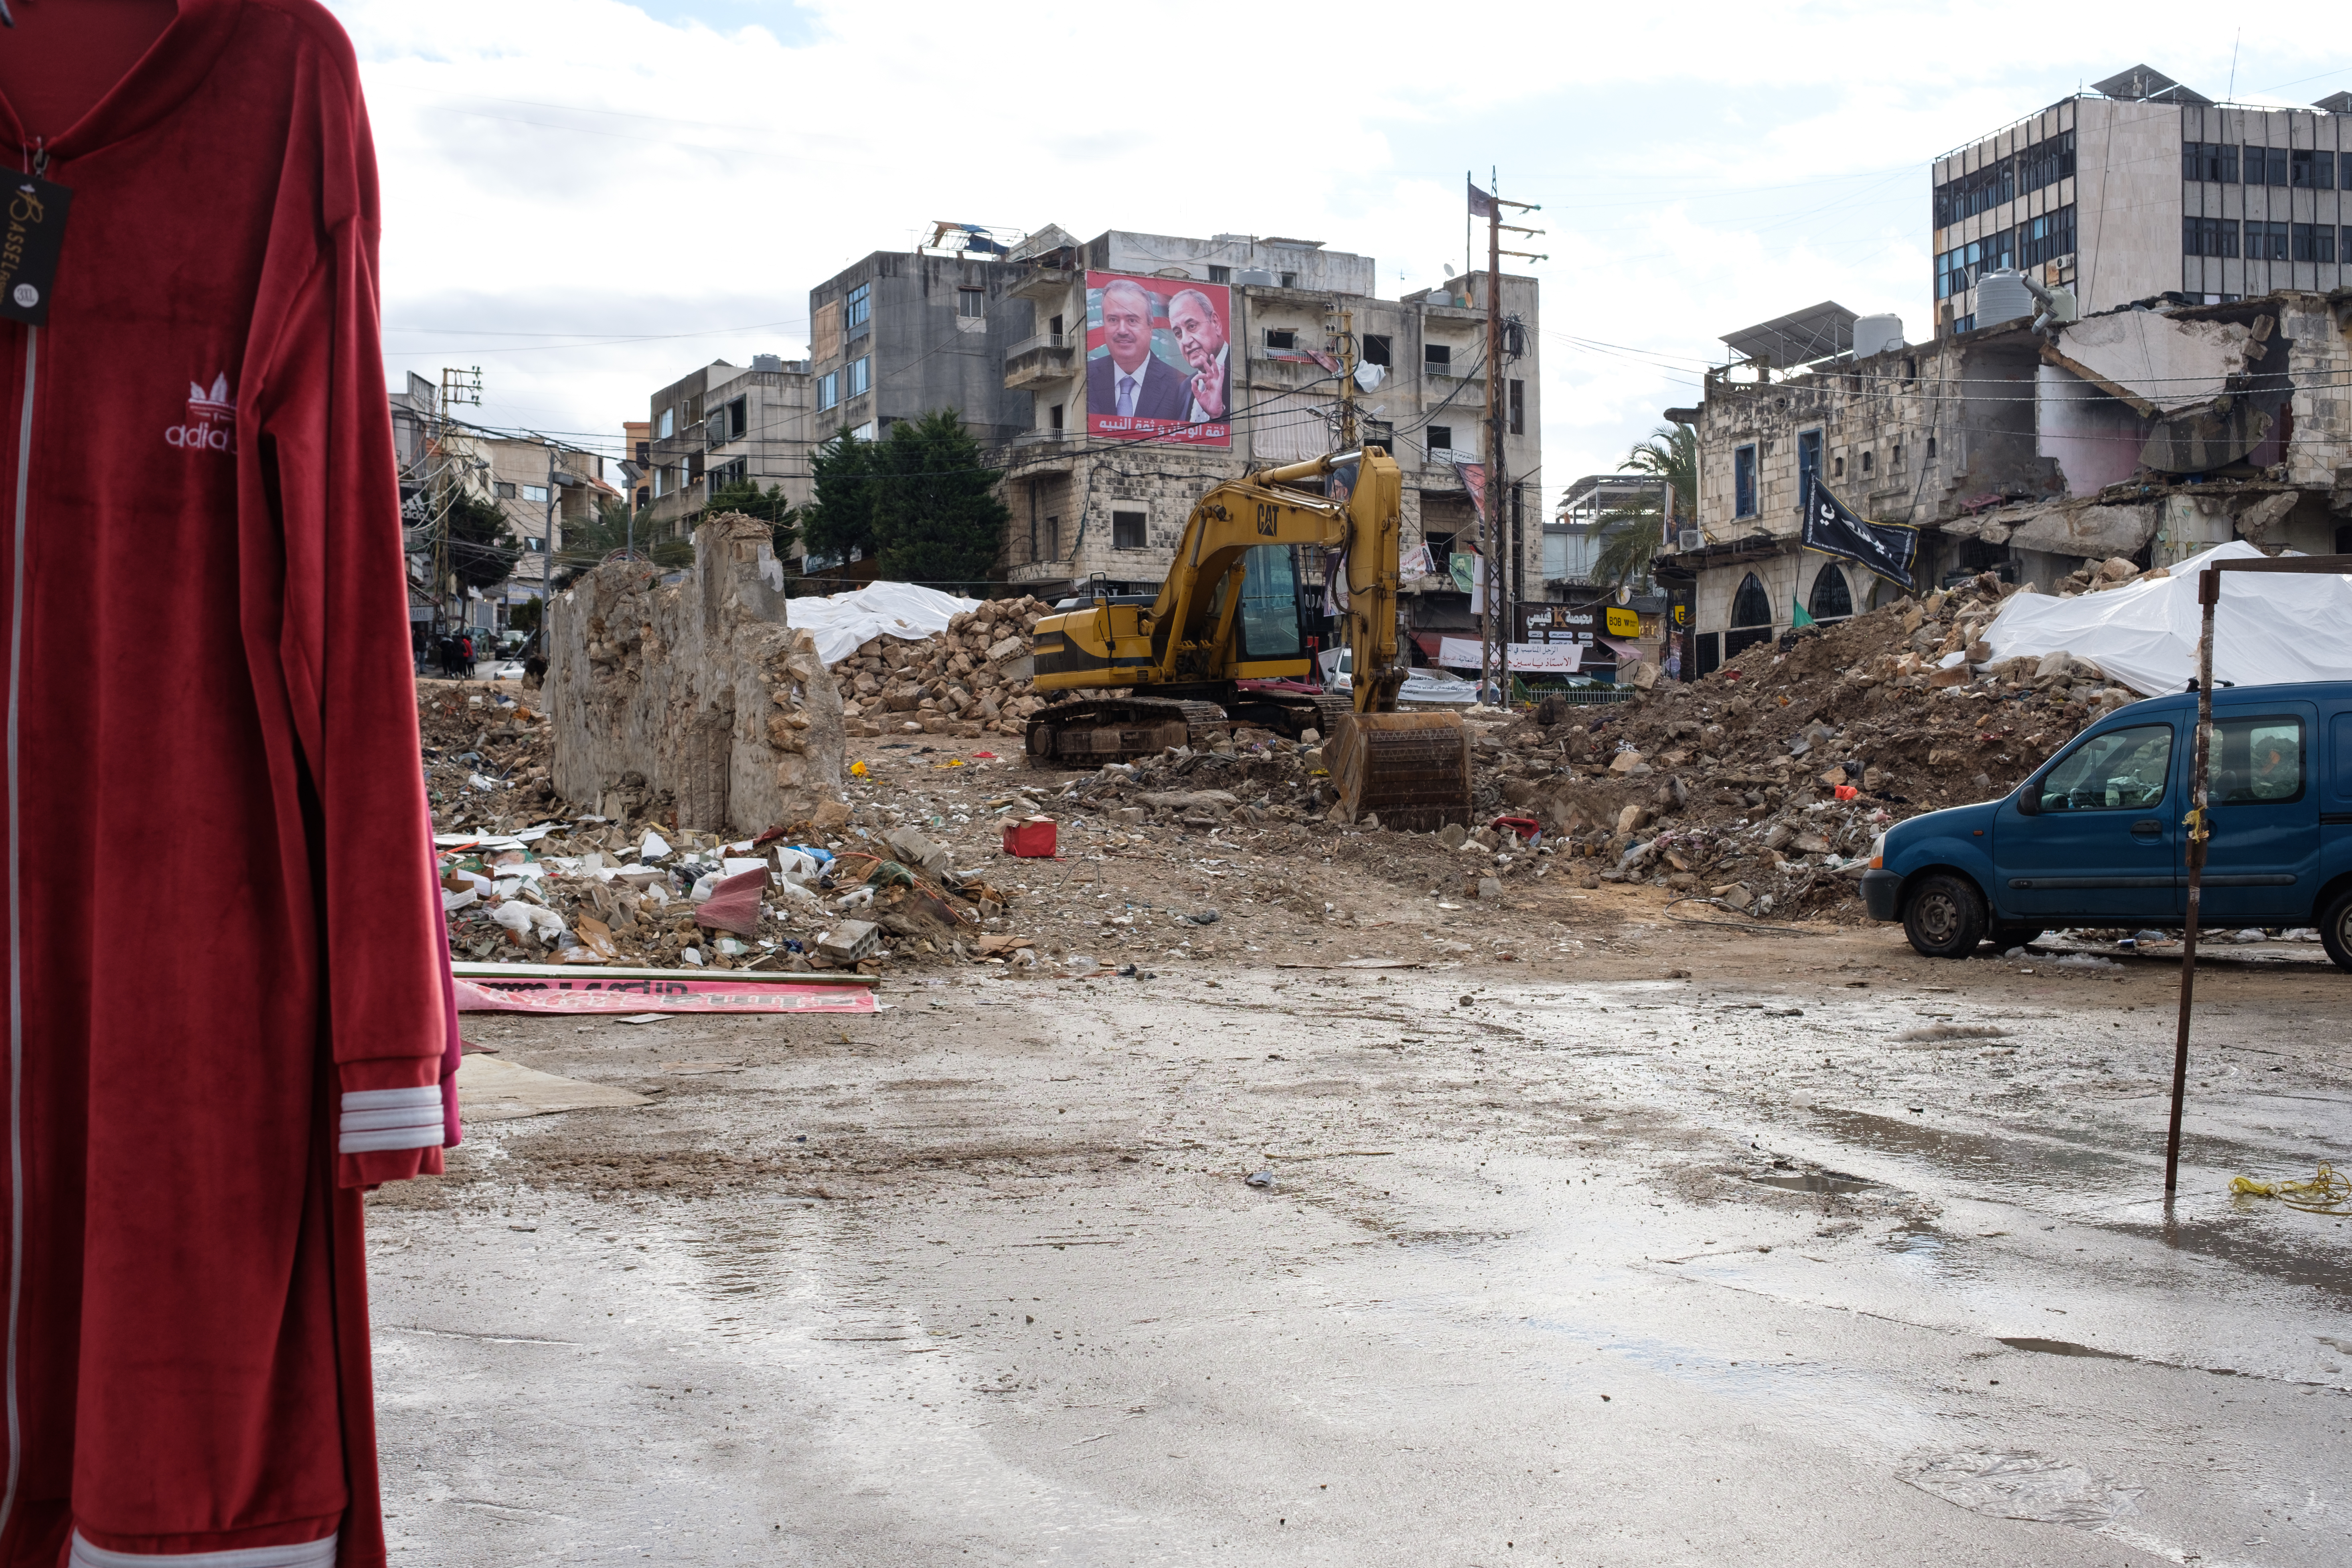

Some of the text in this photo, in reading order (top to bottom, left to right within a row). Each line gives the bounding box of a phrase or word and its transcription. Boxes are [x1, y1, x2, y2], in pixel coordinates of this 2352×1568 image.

[1, 189, 44, 270] BASSEL
[17, 288, 35, 302] 3XL
[1099, 417, 1131, 432] النبيه
[1135, 419, 1155, 432] ثقة
[1168, 422, 1202, 438] الوطن
[1205, 425, 1224, 437] ثقة
[1257, 503, 1280, 537] CAT
[1552, 606, 1569, 628] K
